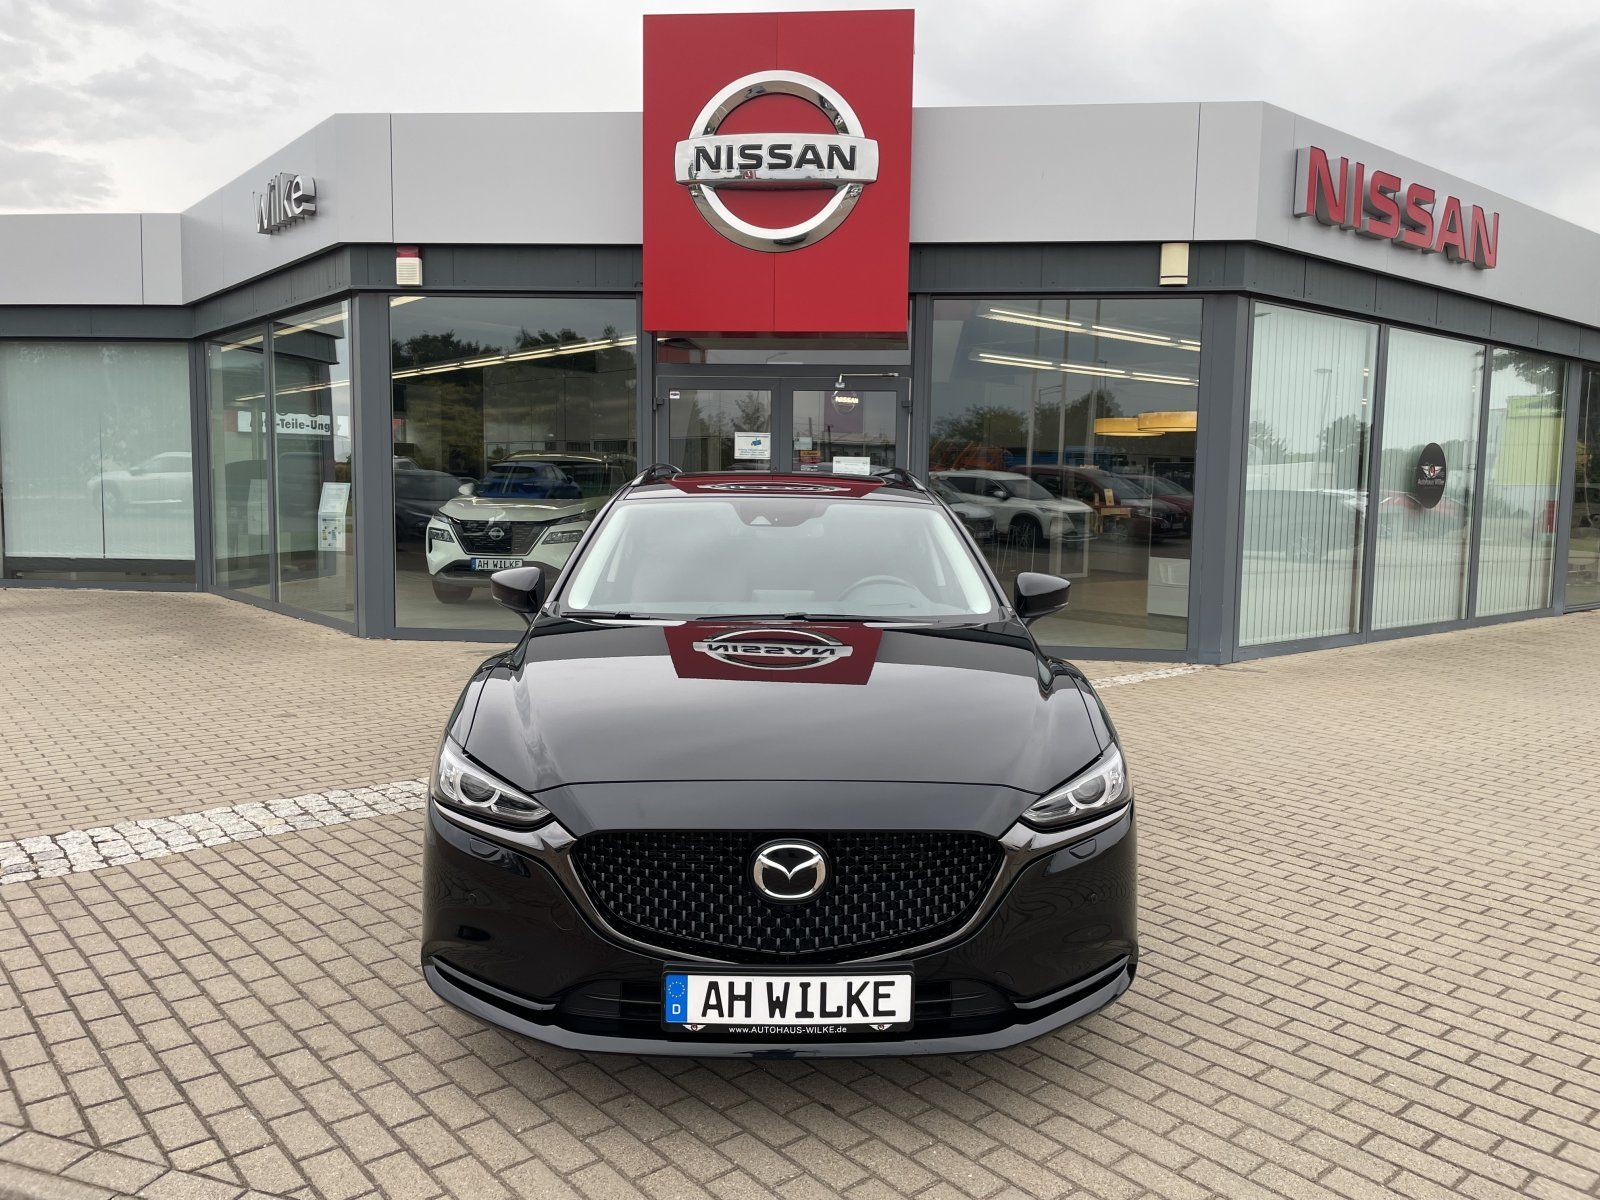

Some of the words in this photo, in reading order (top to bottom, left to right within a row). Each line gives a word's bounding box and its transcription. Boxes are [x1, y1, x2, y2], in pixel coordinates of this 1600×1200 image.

[695, 143, 856, 171] NISSAN
[1295, 145, 1500, 269] NISSAN
[478, 560, 489, 568] AH
[671, 1003, 681, 1015] D
[701, 981, 752, 1018] AH
[766, 981, 896, 1019] WILKE
[728, 1025, 847, 1035] www.AUTOHAUS-WILKE.de
